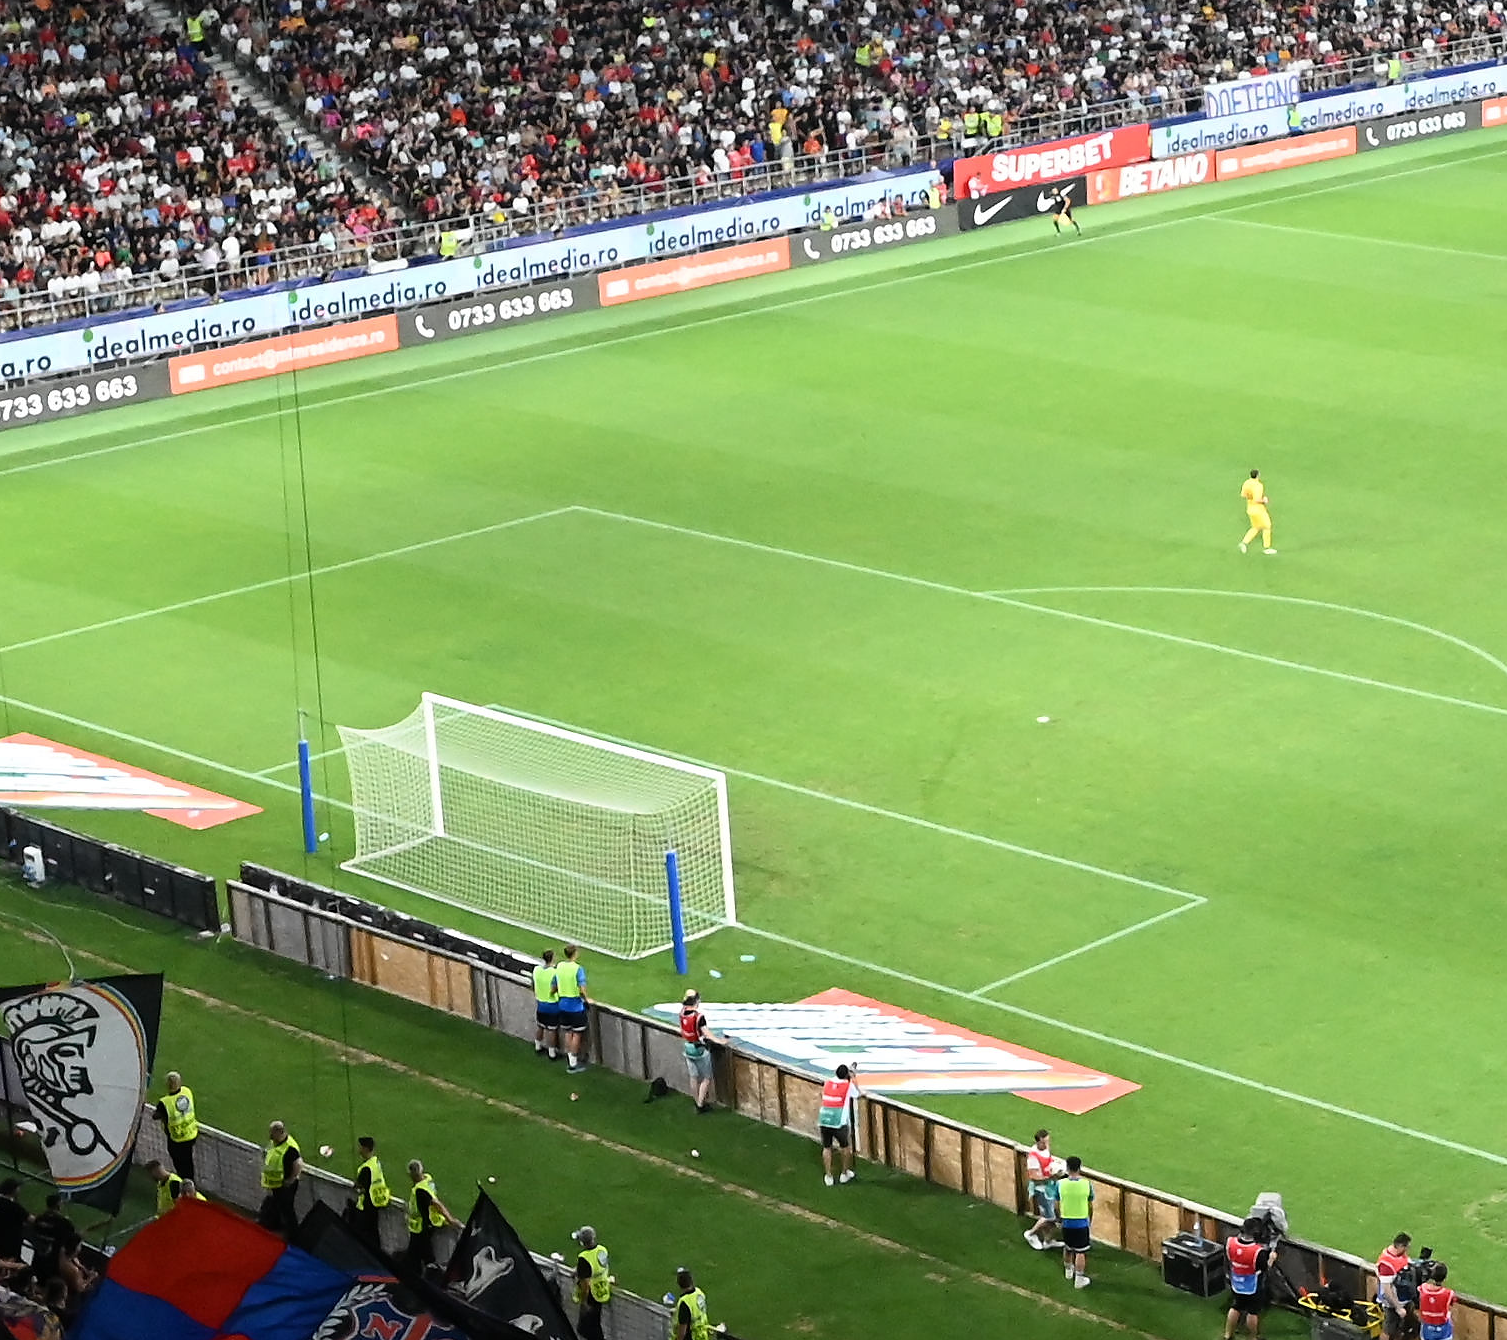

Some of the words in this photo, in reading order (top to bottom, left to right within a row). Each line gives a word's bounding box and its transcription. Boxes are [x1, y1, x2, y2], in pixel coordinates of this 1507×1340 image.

[1165, 123, 1269, 154] idealmedia.ro
[992, 132, 1114, 185] SUPERBET
[1119, 152, 1208, 197] BETANO
[646, 212, 780, 253] idealmedia.ro
[474, 249, 618, 288] idealmedia.ro
[288, 283, 446, 322] idealmedia.ro
[448, 304, 496, 331] 0733
[499, 297, 535, 321] 633
[83, 313, 255, 362] idealmedia.ro
[47, 383, 91, 411] 633
[95, 374, 138, 402] 663
